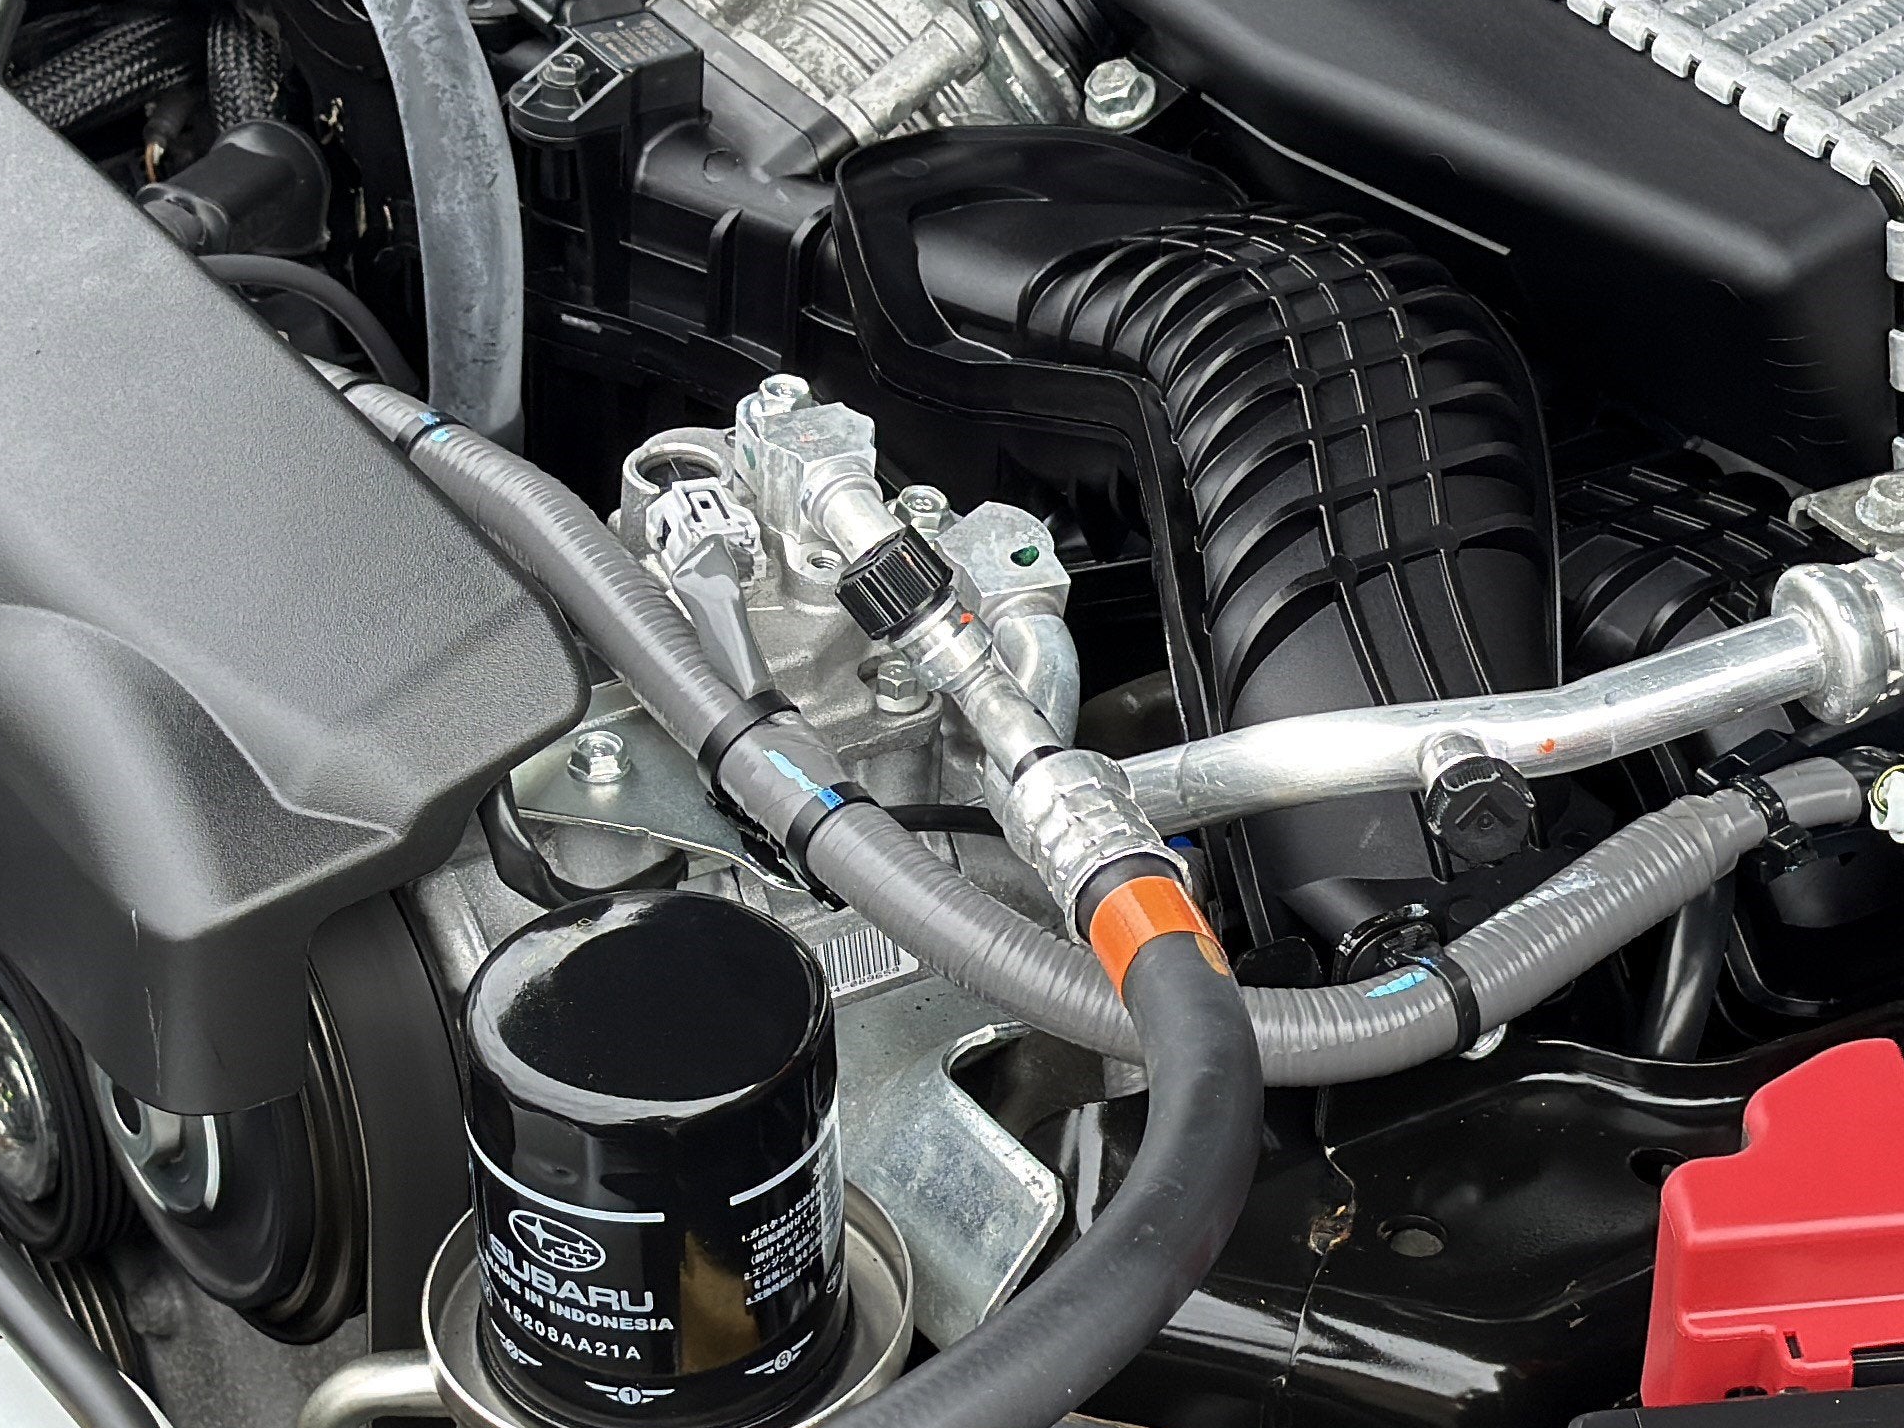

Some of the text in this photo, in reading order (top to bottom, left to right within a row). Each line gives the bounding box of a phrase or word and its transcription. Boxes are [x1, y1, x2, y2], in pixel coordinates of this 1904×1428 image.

[485, 1249, 521, 1294] MADE
[524, 1287, 544, 1309] IN
[549, 1300, 674, 1331] INDONESIA
[489, 1233, 654, 1313] SUBARU
[503, 1297, 642, 1361] 15208AA21A
